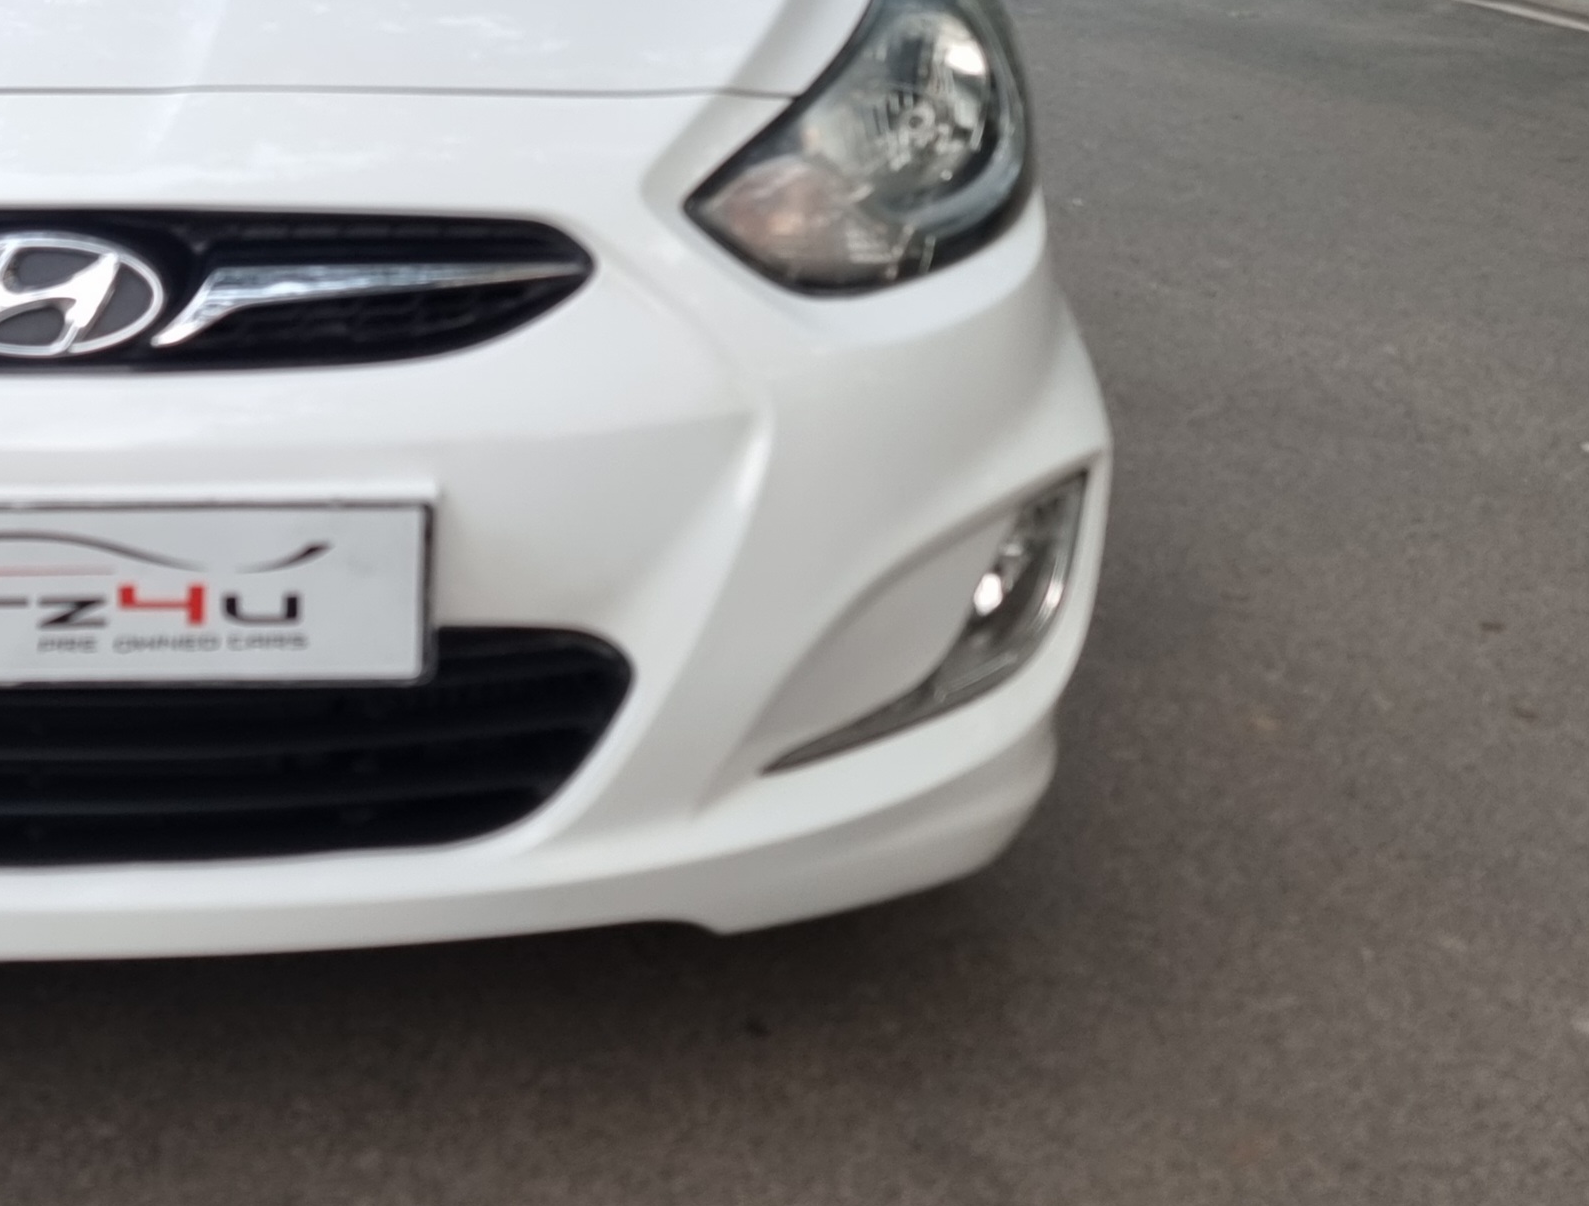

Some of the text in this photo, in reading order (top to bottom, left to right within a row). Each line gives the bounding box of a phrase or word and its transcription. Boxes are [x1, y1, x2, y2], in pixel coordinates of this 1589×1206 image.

[36, 631, 308, 654] PRE OWNED CARS
